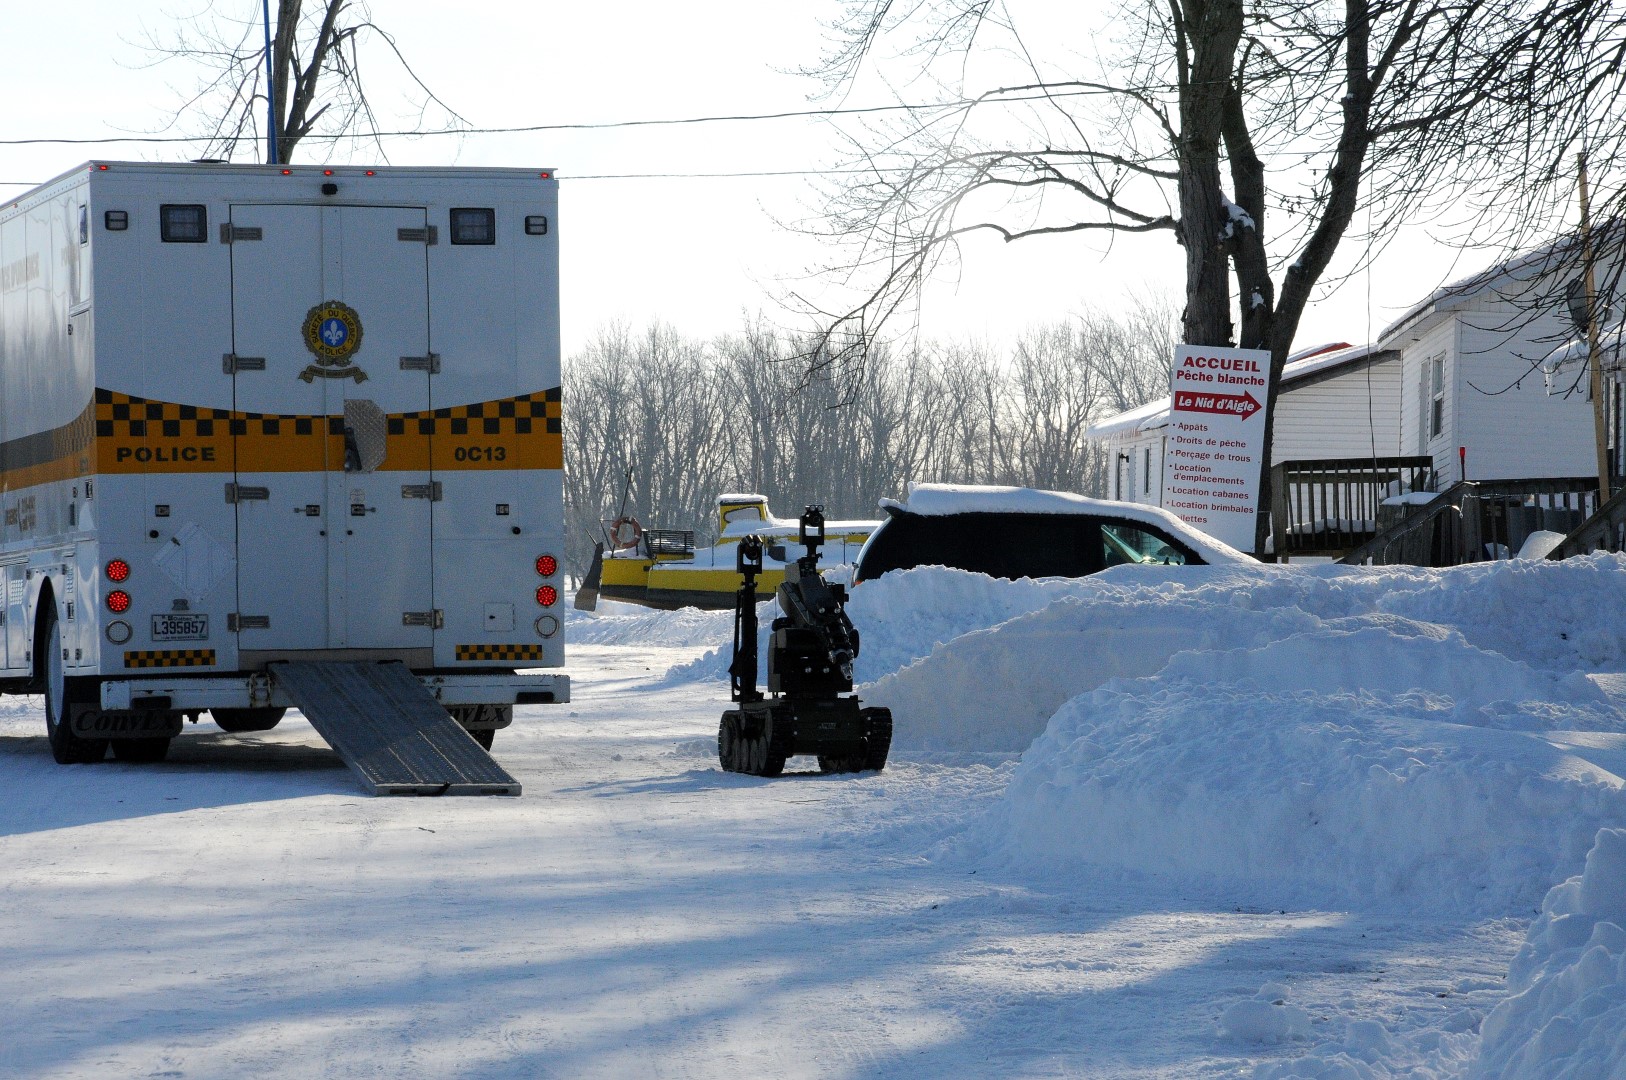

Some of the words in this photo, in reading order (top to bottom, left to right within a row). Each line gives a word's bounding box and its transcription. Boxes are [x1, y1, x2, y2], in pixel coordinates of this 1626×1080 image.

[319, 345, 348, 355] POLICE
[1183, 356, 1261, 372] ACCUEIL
[1176, 370, 1213, 382] Pêche
[1217, 373, 1265, 386] blanche
[1178, 396, 1192, 407] Le
[1195, 397, 1215, 409] Nid
[1217, 399, 1255, 413] d'Aigle
[1176, 436, 1203, 445] Droits
[1205, 438, 1217, 446] de
[1219, 440, 1247, 448] pêche
[116, 447, 215, 462] POLICE
[1175, 449, 1211, 461] Perçage
[1228, 454, 1251, 462] trous
[1174, 463, 1212, 473] Location
[1173, 473, 1245, 485] d'emplacements
[1172, 486, 1209, 496] Location
[1212, 491, 1249, 500] cabanes
[1171, 500, 1208, 510] Location
[1211, 503, 1254, 513] brimbales
[1177, 514, 1208, 523] ilettes
[154, 620, 206, 635] L395857
